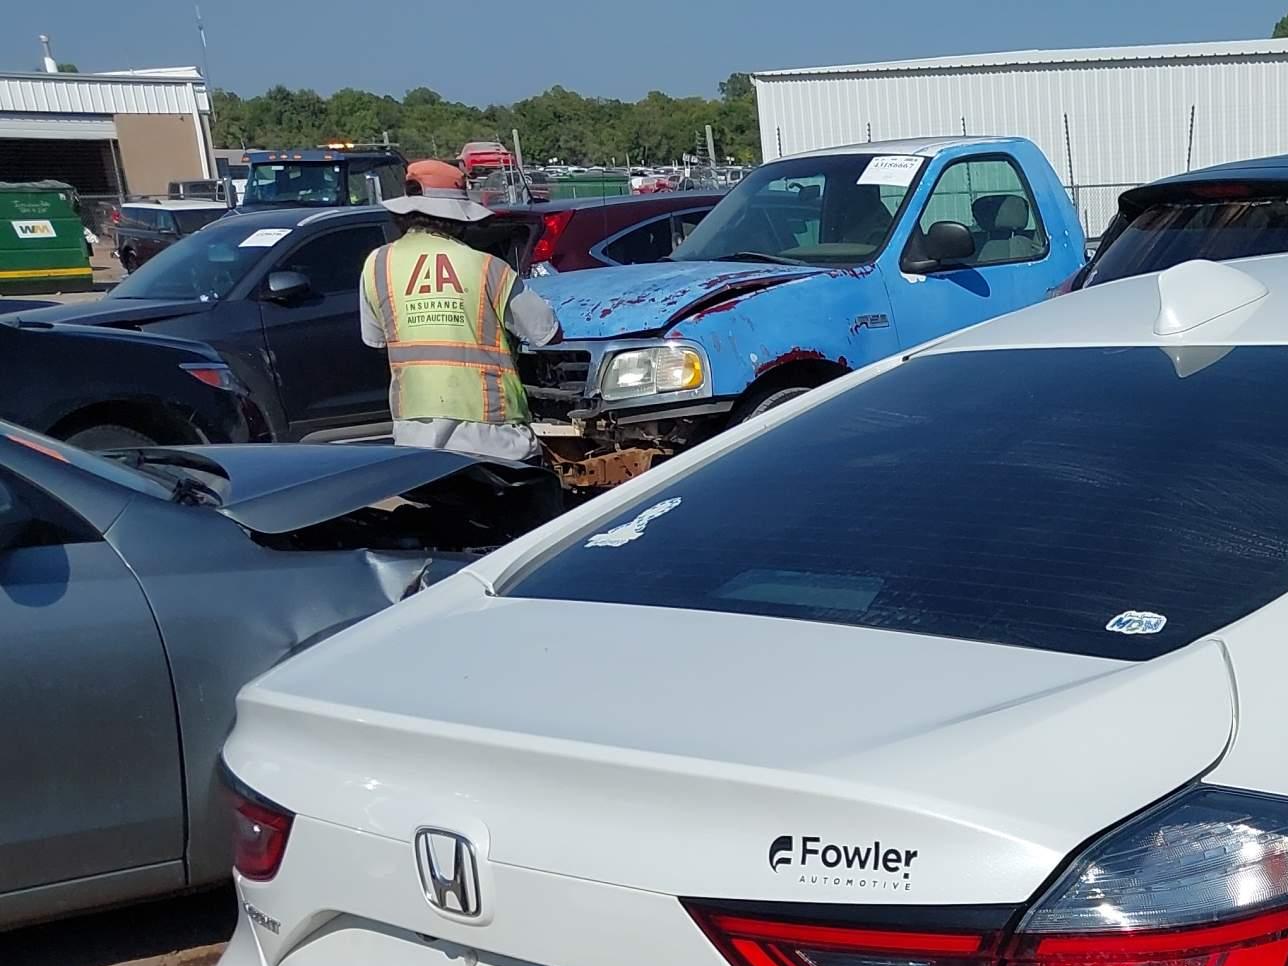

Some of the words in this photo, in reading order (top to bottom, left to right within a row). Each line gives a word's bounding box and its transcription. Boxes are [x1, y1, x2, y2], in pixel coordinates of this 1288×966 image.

[19, 224, 50, 234] WM
[405, 301, 464, 311] INSURANCE
[407, 315, 425, 324] AUTO
[426, 313, 465, 323] AUCTIONS
[799, 875, 912, 891] AUTOMOTIVE
